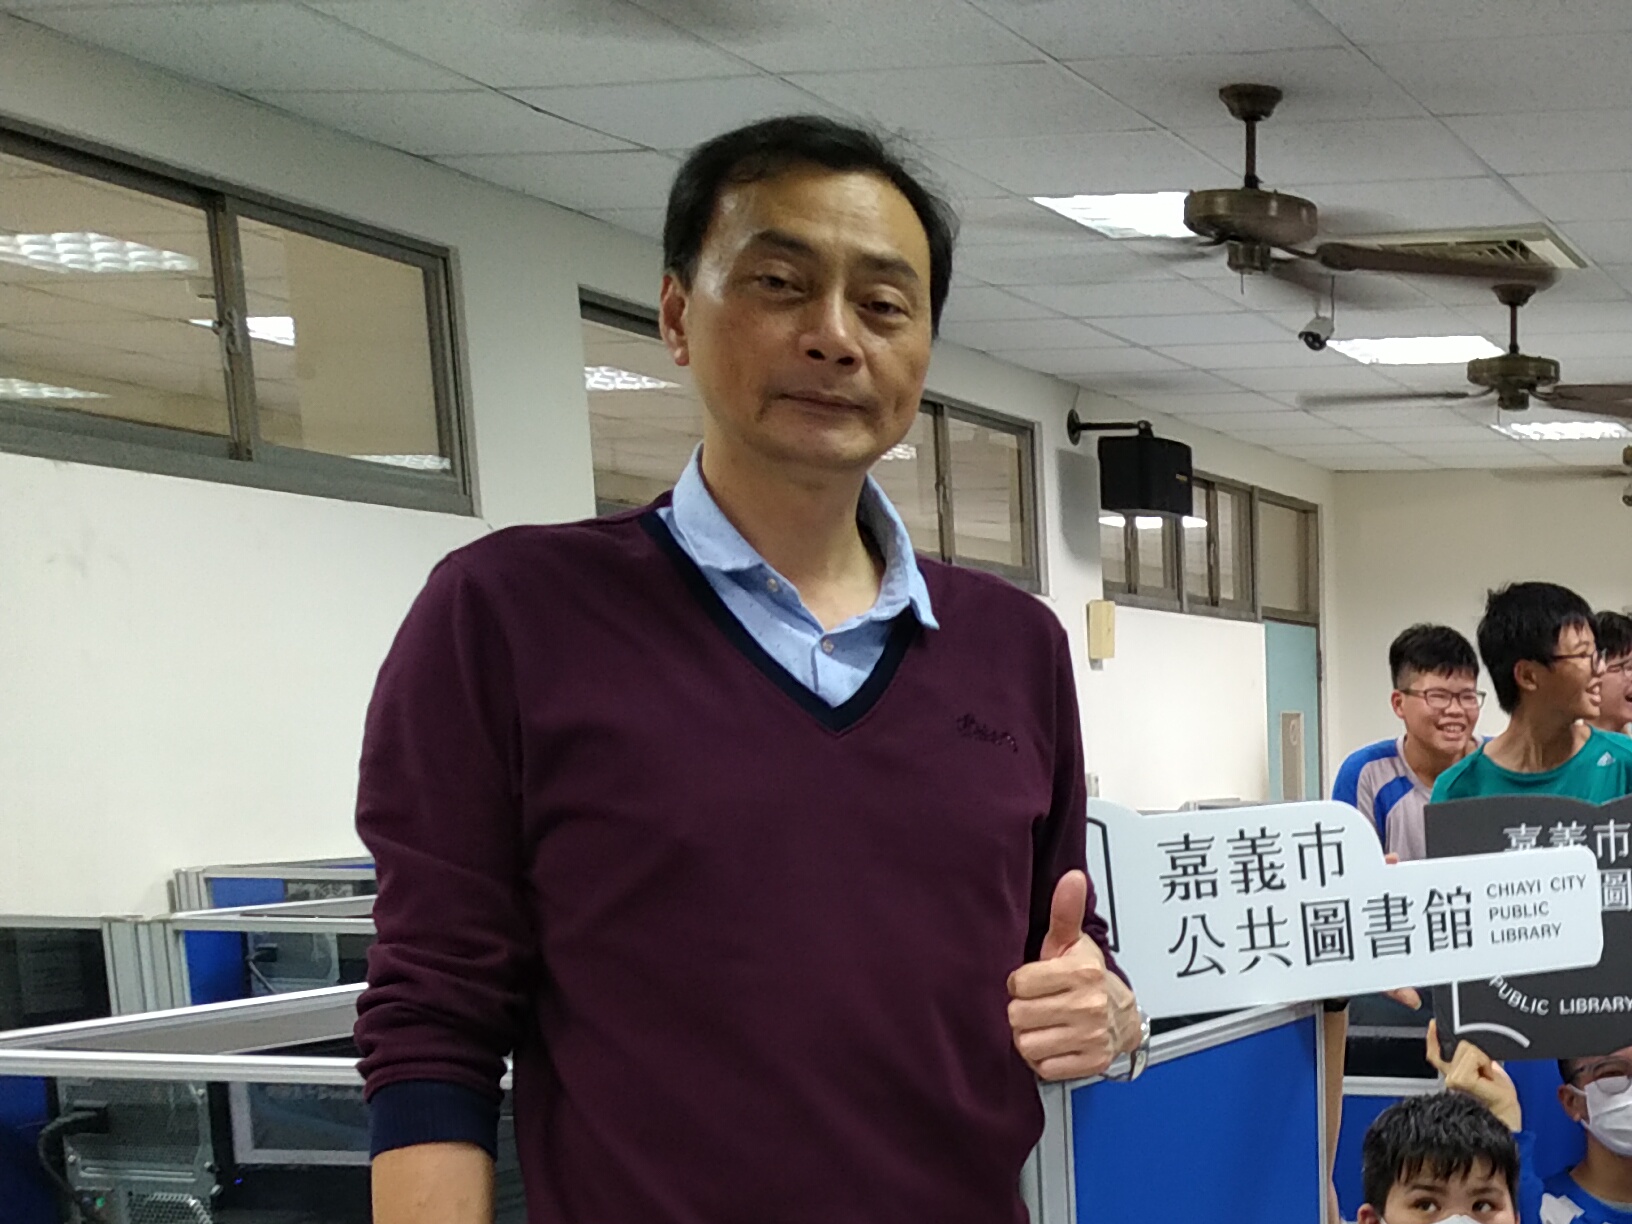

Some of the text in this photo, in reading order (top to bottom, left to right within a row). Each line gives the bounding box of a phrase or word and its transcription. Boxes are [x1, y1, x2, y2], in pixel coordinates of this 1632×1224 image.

[1157, 821, 1347, 903] 嘉義市
[1486, 874, 1586, 899] CHIAYI CITY
[1489, 901, 1549, 921] PUBLIC
[1168, 885, 1474, 978] 公共圖書館
[1490, 922, 1561, 944] LIBRARY
[1489, 975, 1549, 1016] PUBLIC
